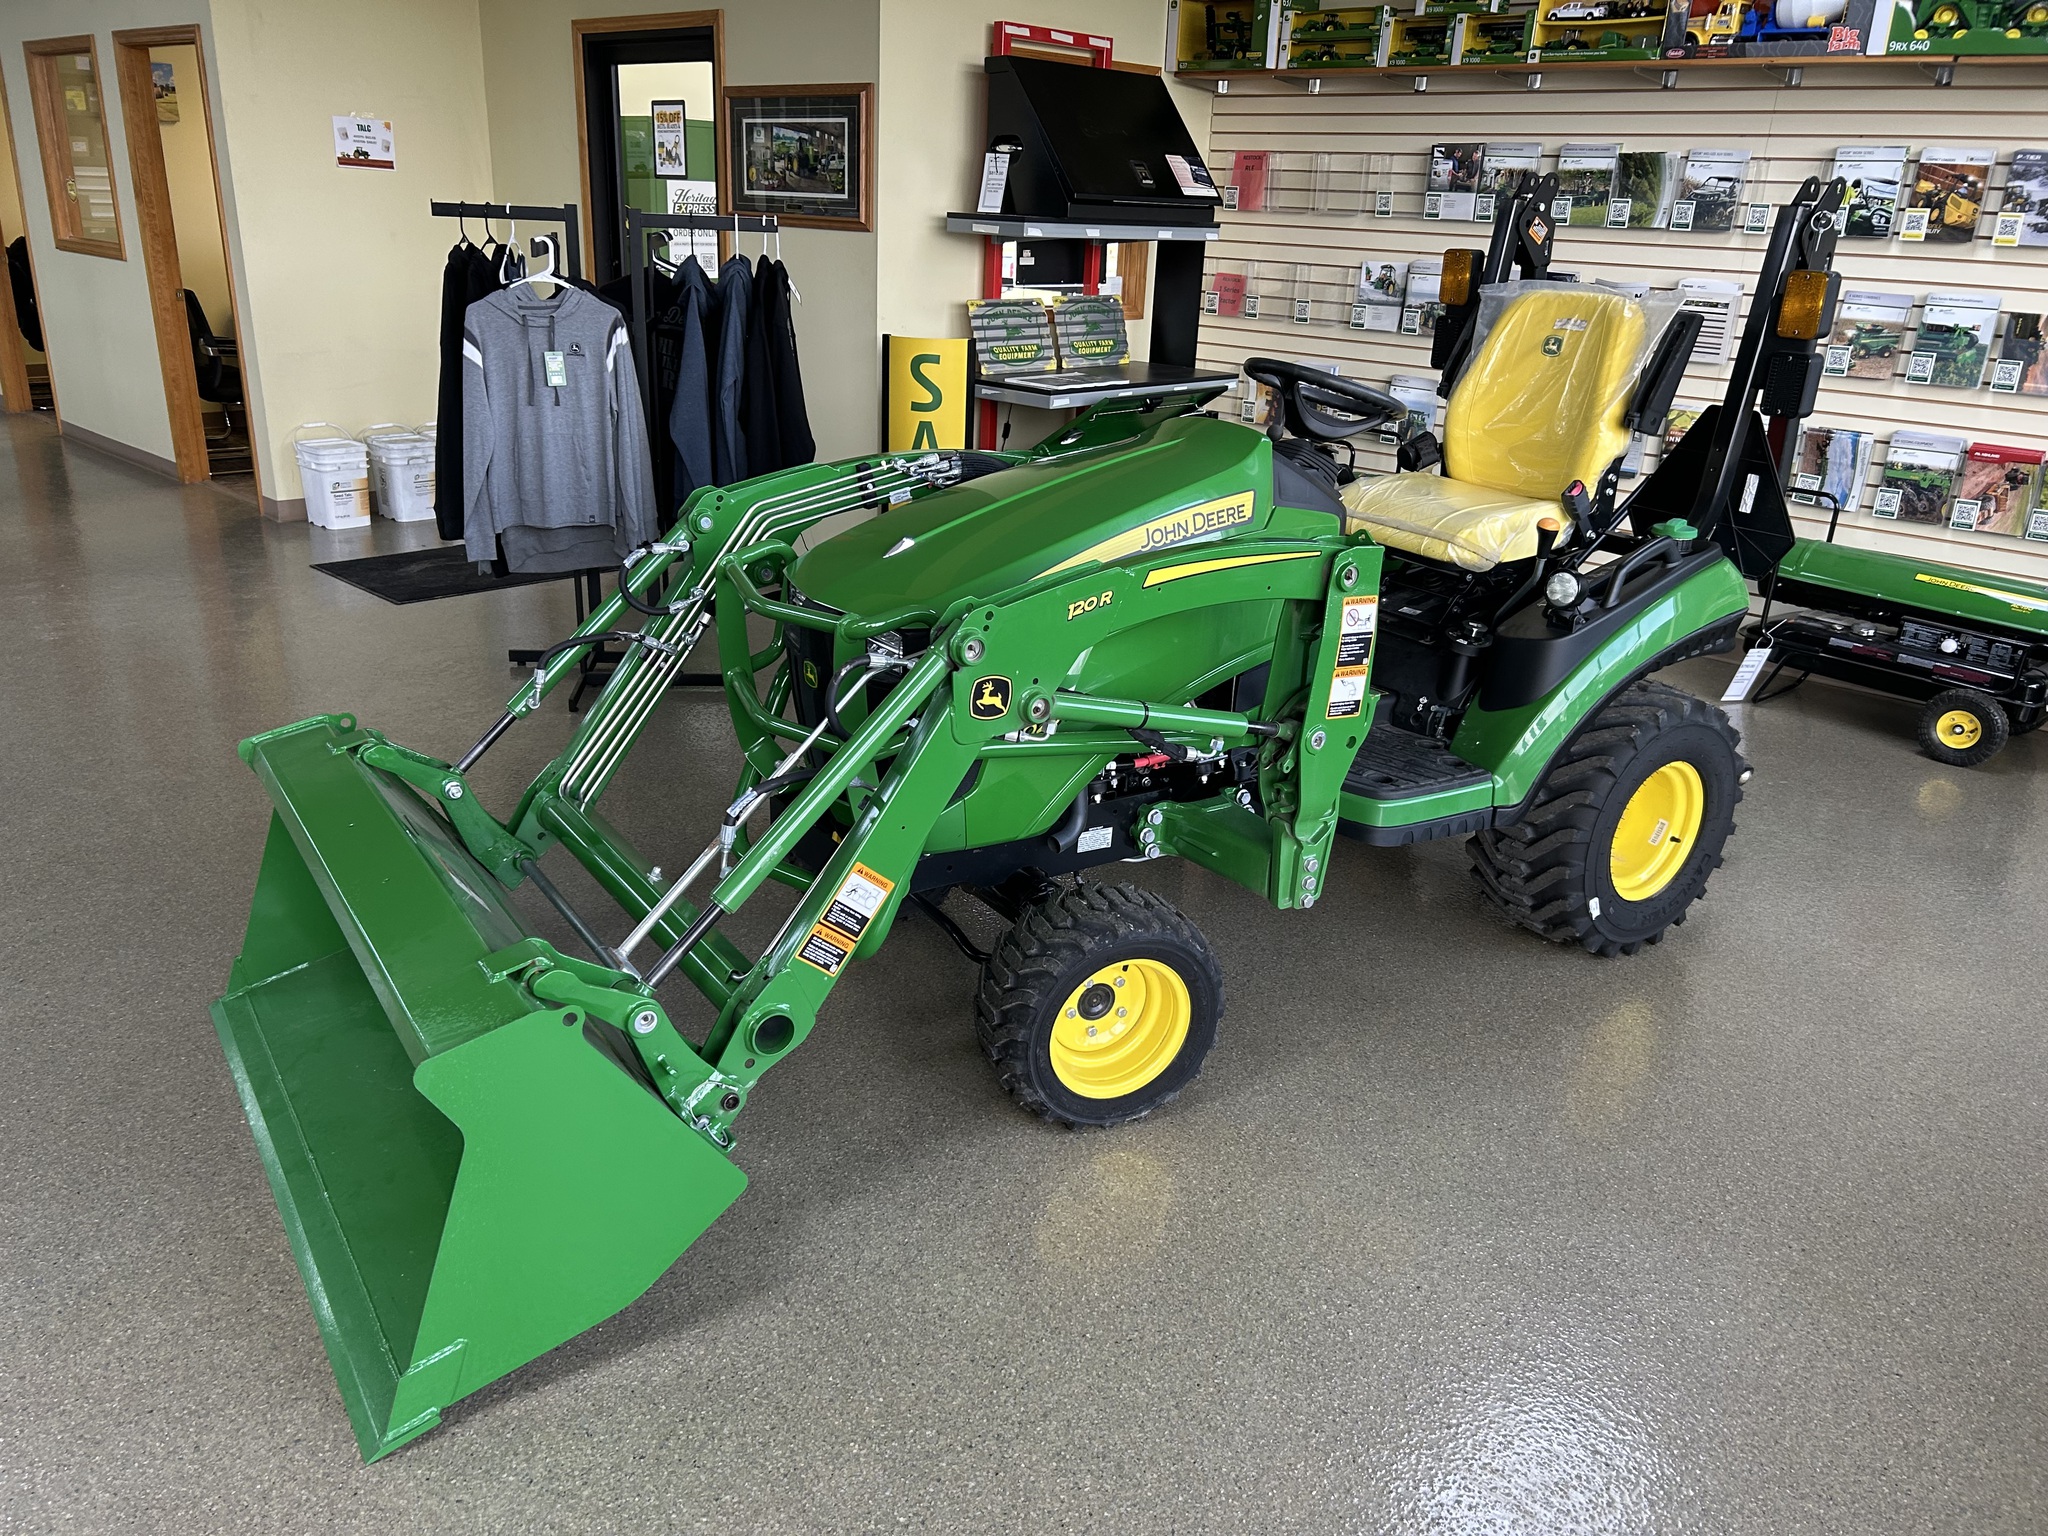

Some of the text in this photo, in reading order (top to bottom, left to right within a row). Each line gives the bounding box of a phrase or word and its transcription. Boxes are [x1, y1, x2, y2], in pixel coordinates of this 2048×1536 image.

[1831, 26, 1860, 44] Big
[1889, 40, 1930, 51] 9RX 640
[669, 112, 682, 123] OFF
[356, 123, 372, 133] TALC
[674, 203, 716, 214] EXPRESS
[673, 229, 717, 238] ORDER ONLI
[993, 344, 1038, 354] QUALITY FARM
[1073, 339, 1114, 349] QUALITY FARM
[1078, 346, 1112, 354] EQUIPMENT
[999, 351, 1035, 361] EQUIPMENT
[1140, 503, 1246, 549] JOHN DEERE
[1928, 577, 1949, 586] JOHN
[1350, 596, 1376, 605] WARNING
[1340, 668, 1366, 677] WARNING
[863, 870, 889, 889] WARNING
[824, 931, 850, 949] WARNING
